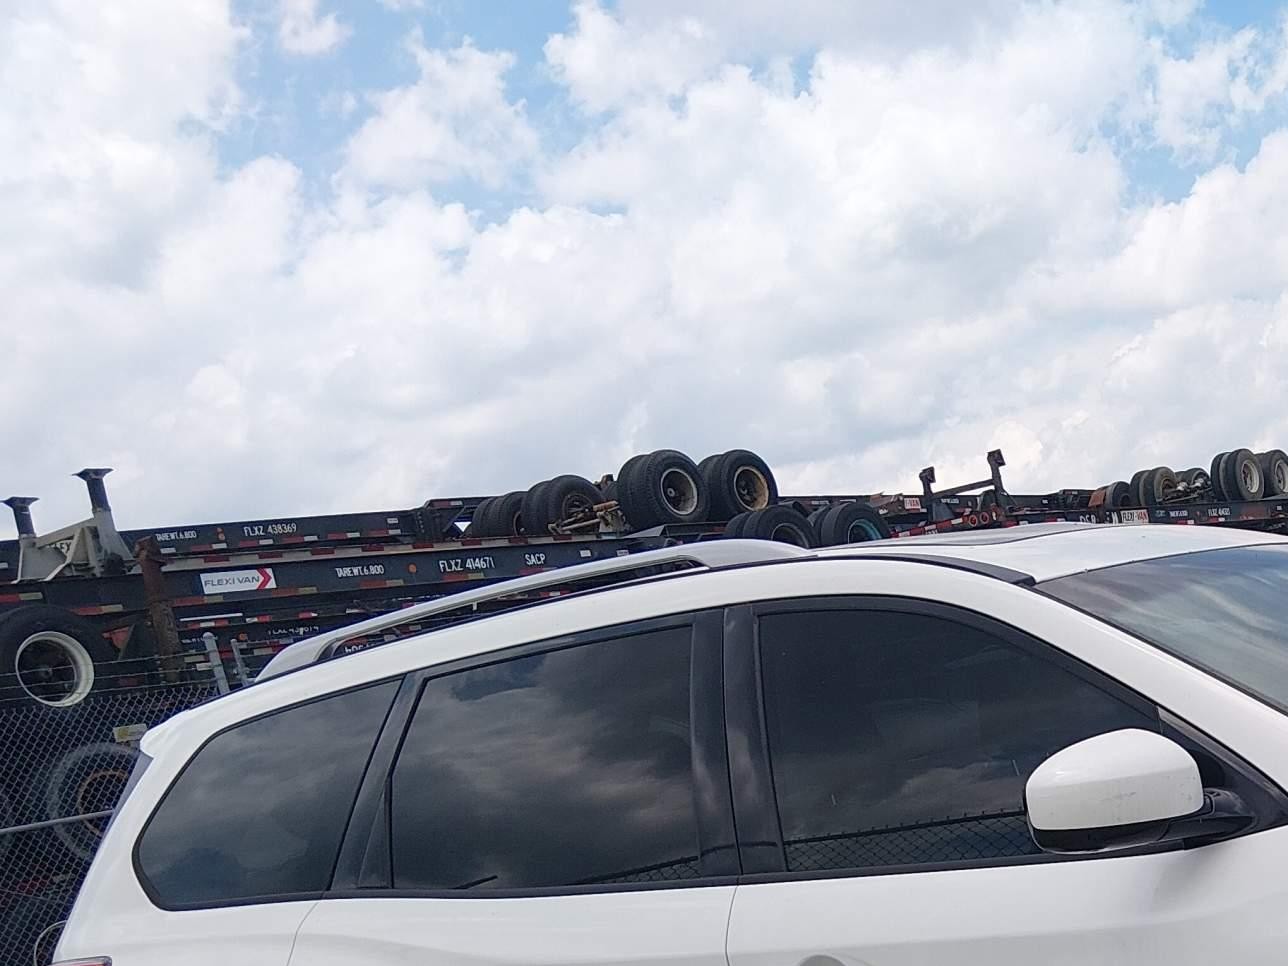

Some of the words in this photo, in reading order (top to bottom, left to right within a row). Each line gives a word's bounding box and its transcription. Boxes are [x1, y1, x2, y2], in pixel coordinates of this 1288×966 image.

[243, 525, 265, 536] FLXZ
[439, 558, 464, 573] FLXZ
[465, 556, 495, 570] 414671
[524, 553, 546, 566] SACP
[236, 575, 260, 584] VAN
